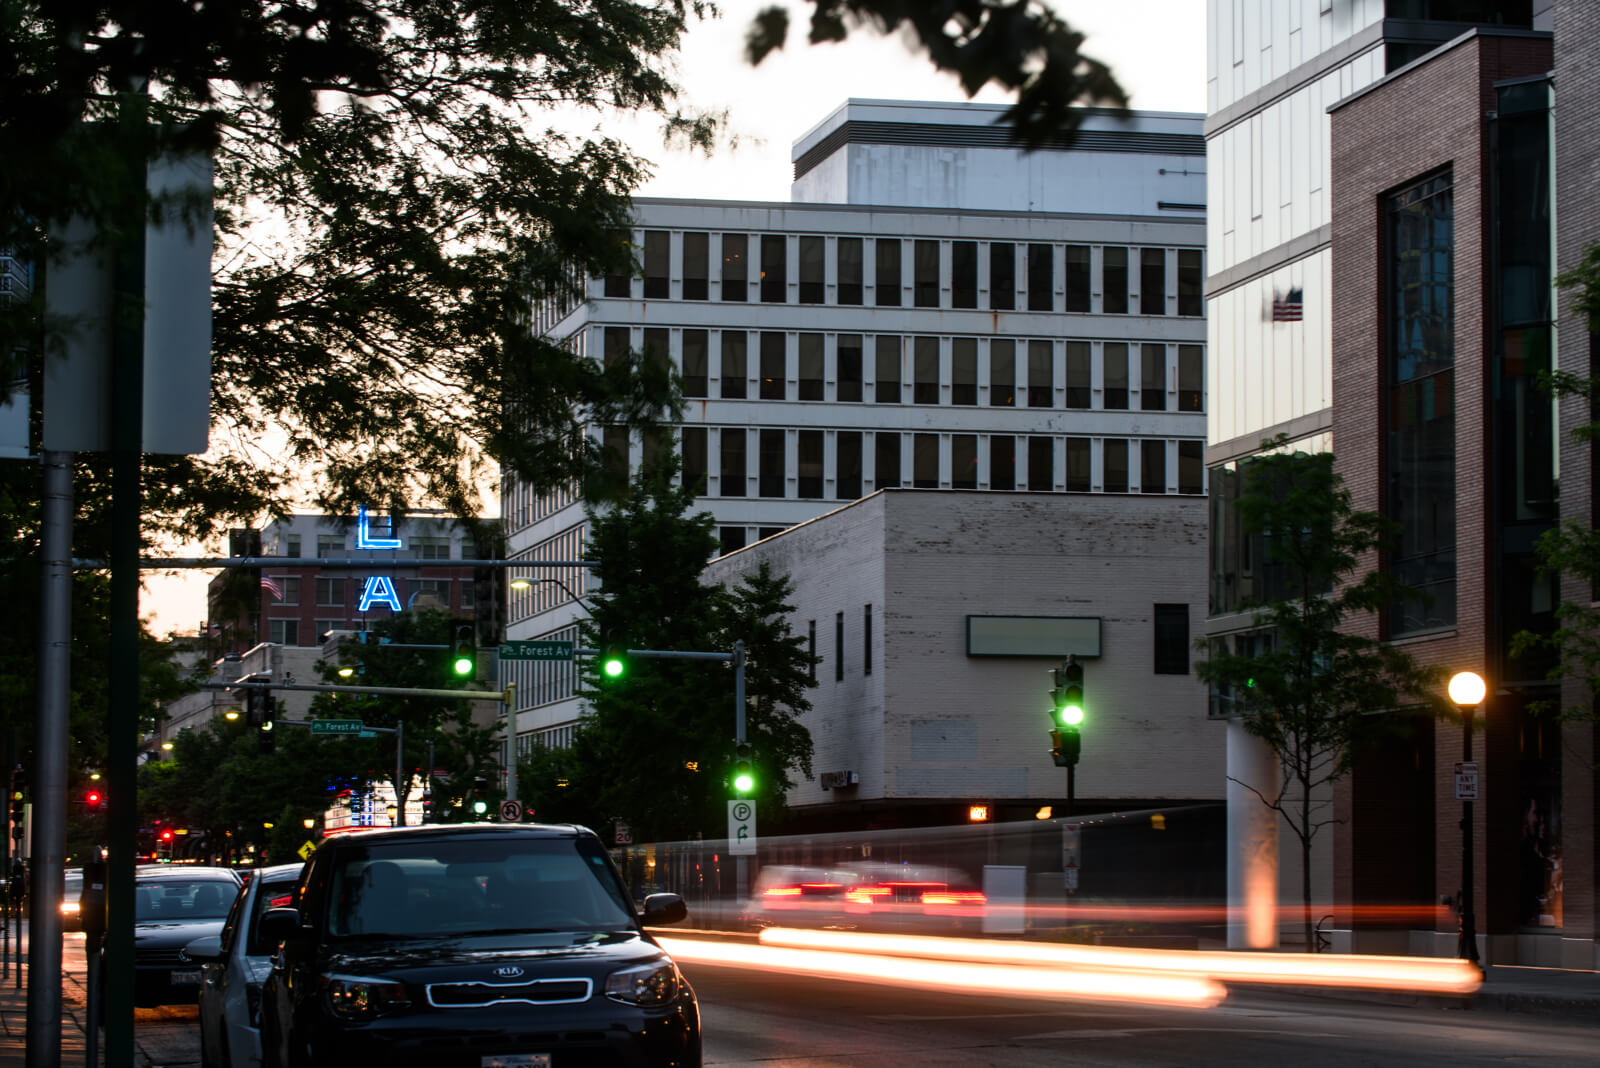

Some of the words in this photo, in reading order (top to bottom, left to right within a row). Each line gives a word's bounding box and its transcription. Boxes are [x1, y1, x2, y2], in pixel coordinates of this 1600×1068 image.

[519, 645, 553, 656] Forest
[555, 645, 570, 656] Av
[326, 722, 349, 730] Forest
[616, 833, 632, 842] 20
[498, 966, 520, 975] KIA
